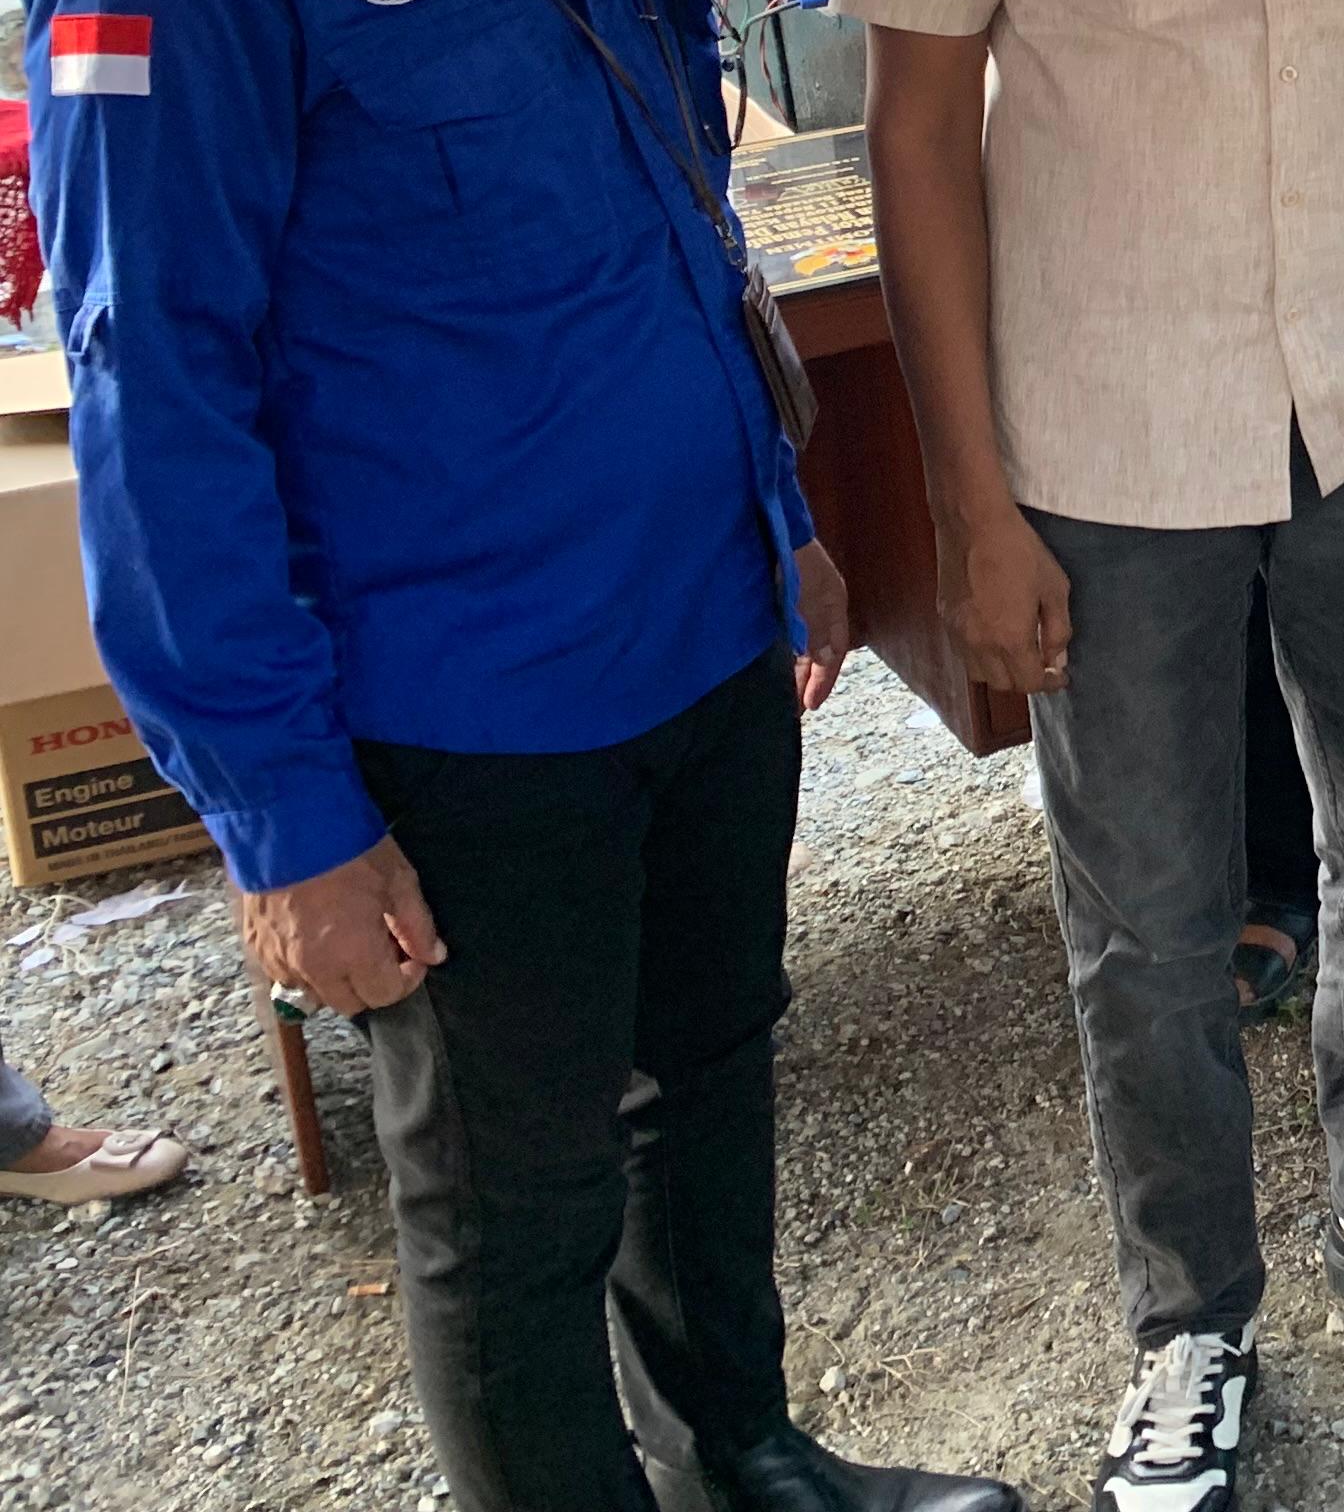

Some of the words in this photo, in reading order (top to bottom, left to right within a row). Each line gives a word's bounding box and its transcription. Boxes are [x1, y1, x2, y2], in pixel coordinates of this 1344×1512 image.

[30, 717, 132, 755] HON
[35, 772, 135, 809] Engine
[42, 813, 146, 849] Moteur
